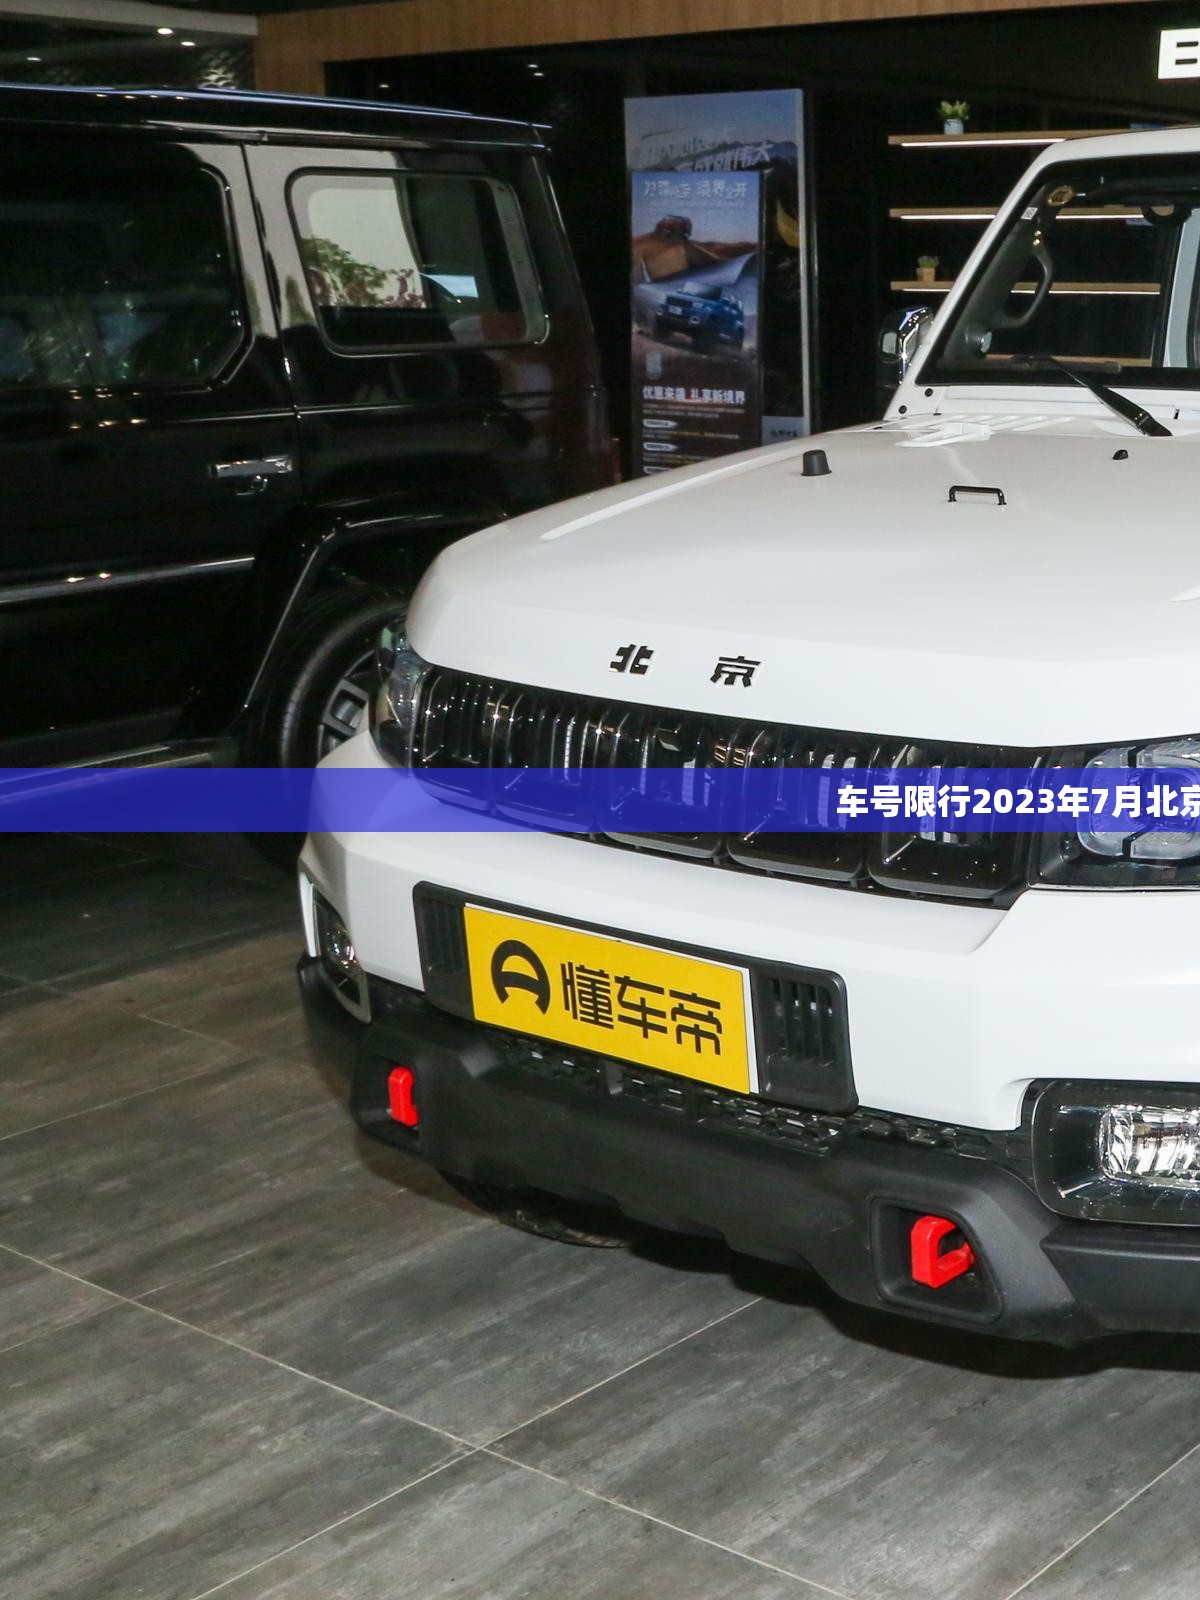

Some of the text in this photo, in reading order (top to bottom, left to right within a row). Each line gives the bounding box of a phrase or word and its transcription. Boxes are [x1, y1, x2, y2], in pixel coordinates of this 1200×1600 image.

[609, 644, 761, 687] 北京
[561, 961, 722, 1056] 懂车帝
